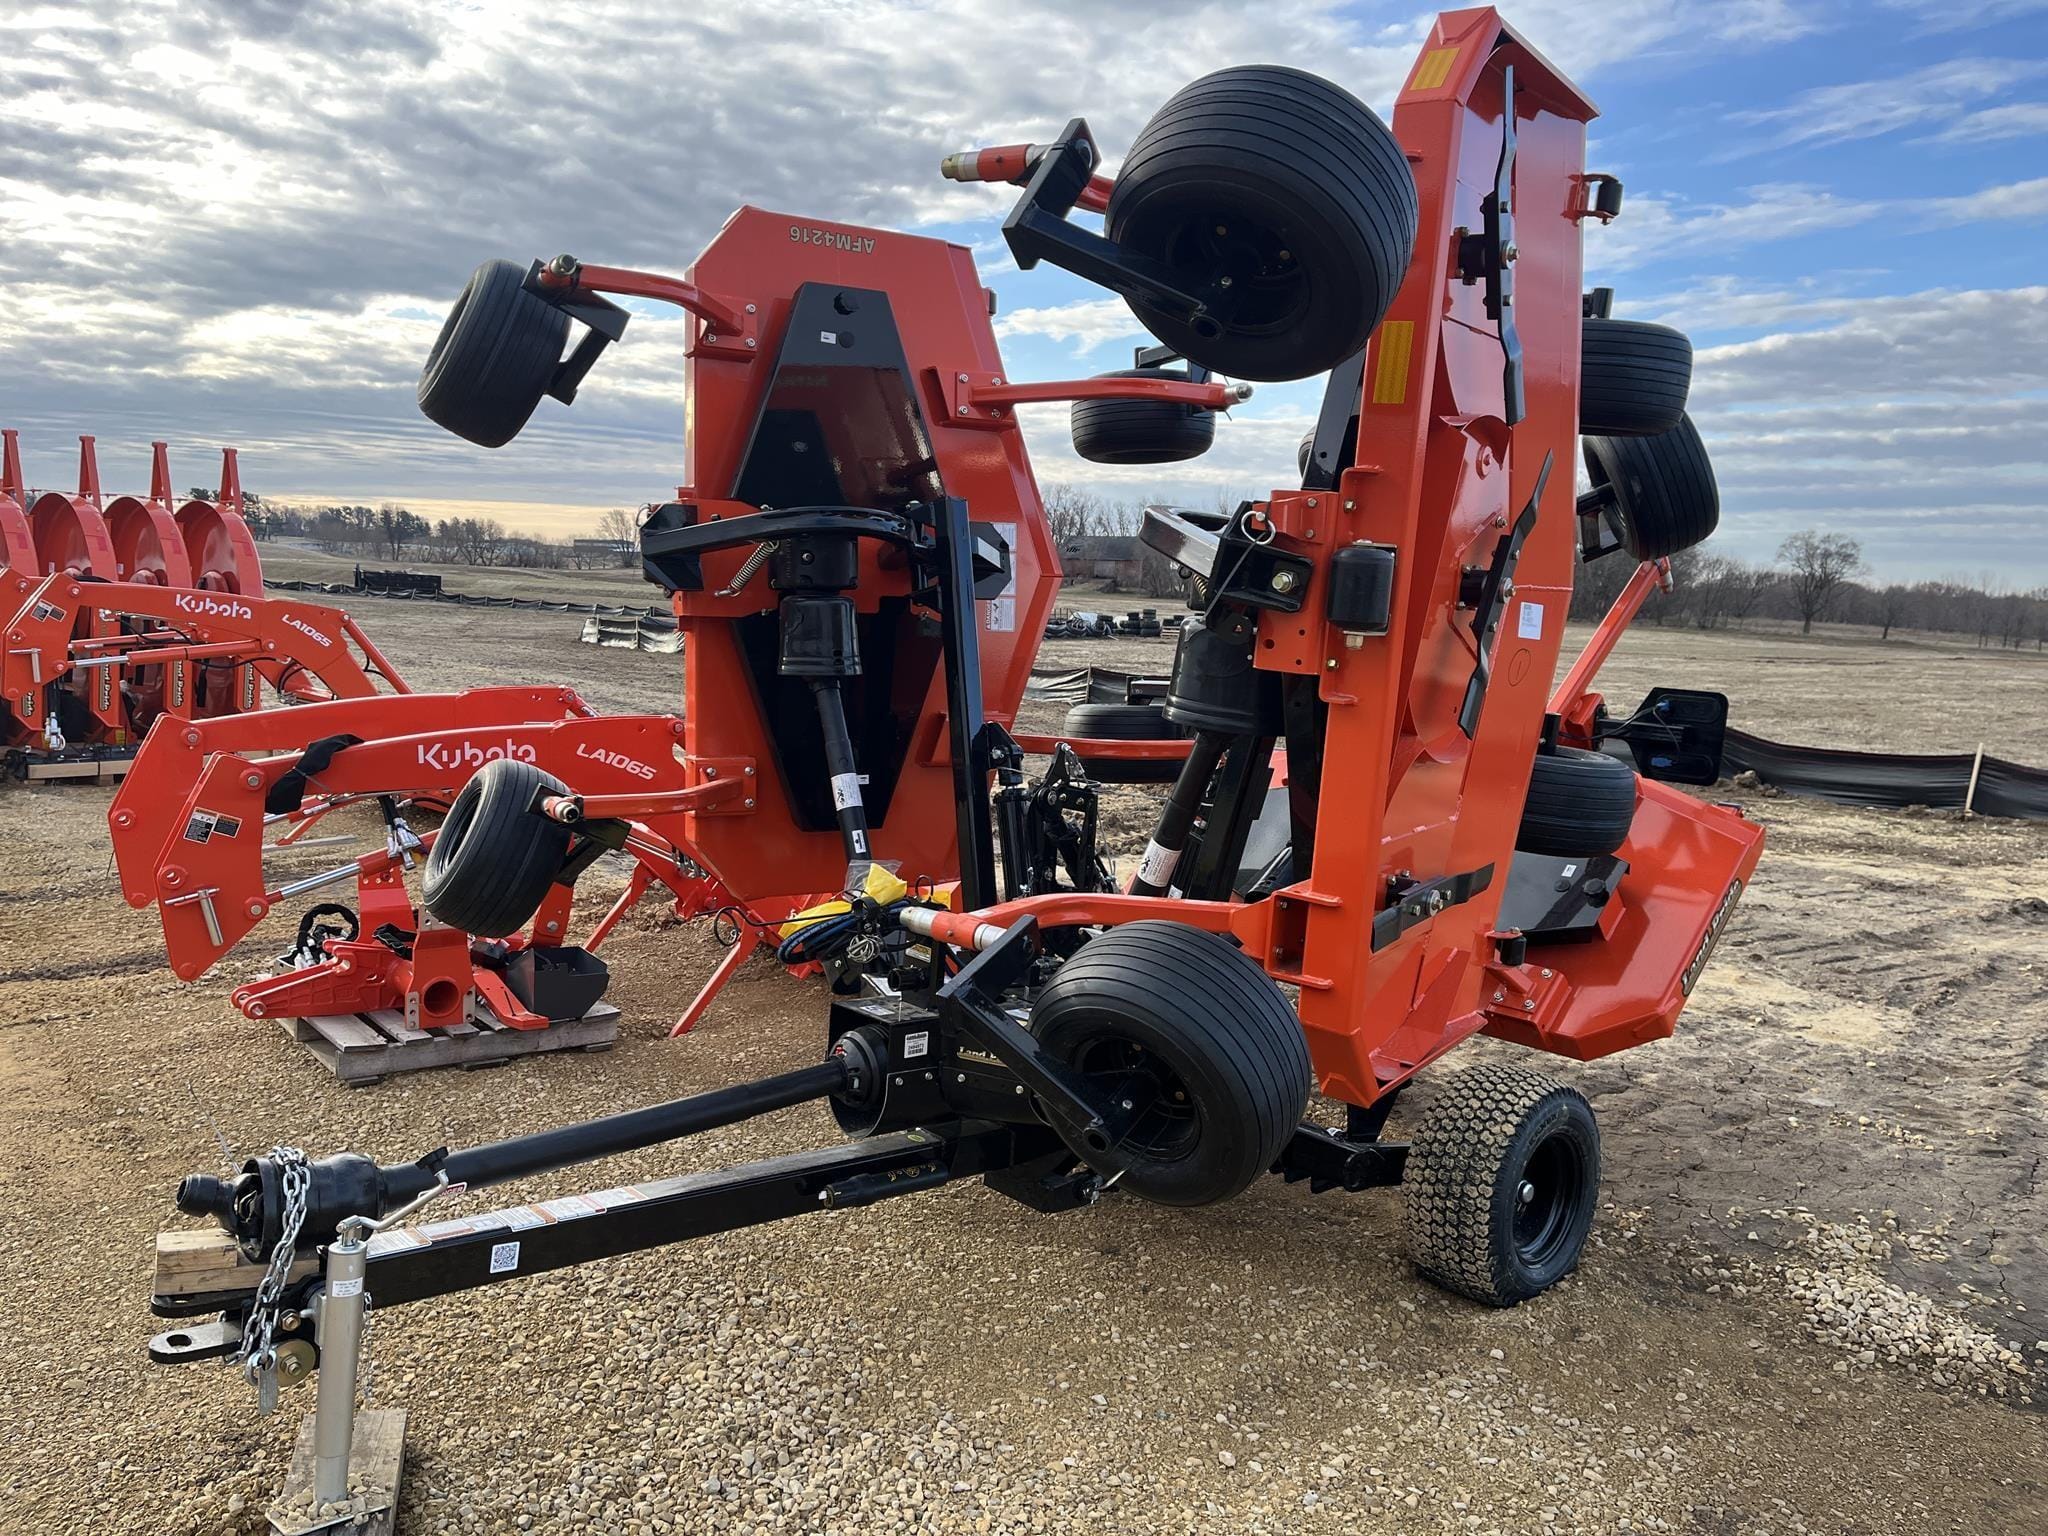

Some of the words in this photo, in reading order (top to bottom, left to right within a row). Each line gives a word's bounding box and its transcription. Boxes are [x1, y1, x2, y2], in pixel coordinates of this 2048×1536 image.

[790, 225, 875, 254] AFM4216
[175, 593, 252, 619] Kubota
[281, 613, 334, 648] LA1065
[417, 738, 537, 770] Kubota
[576, 743, 657, 781] LA1065
[959, 1045, 987, 1058] Land
